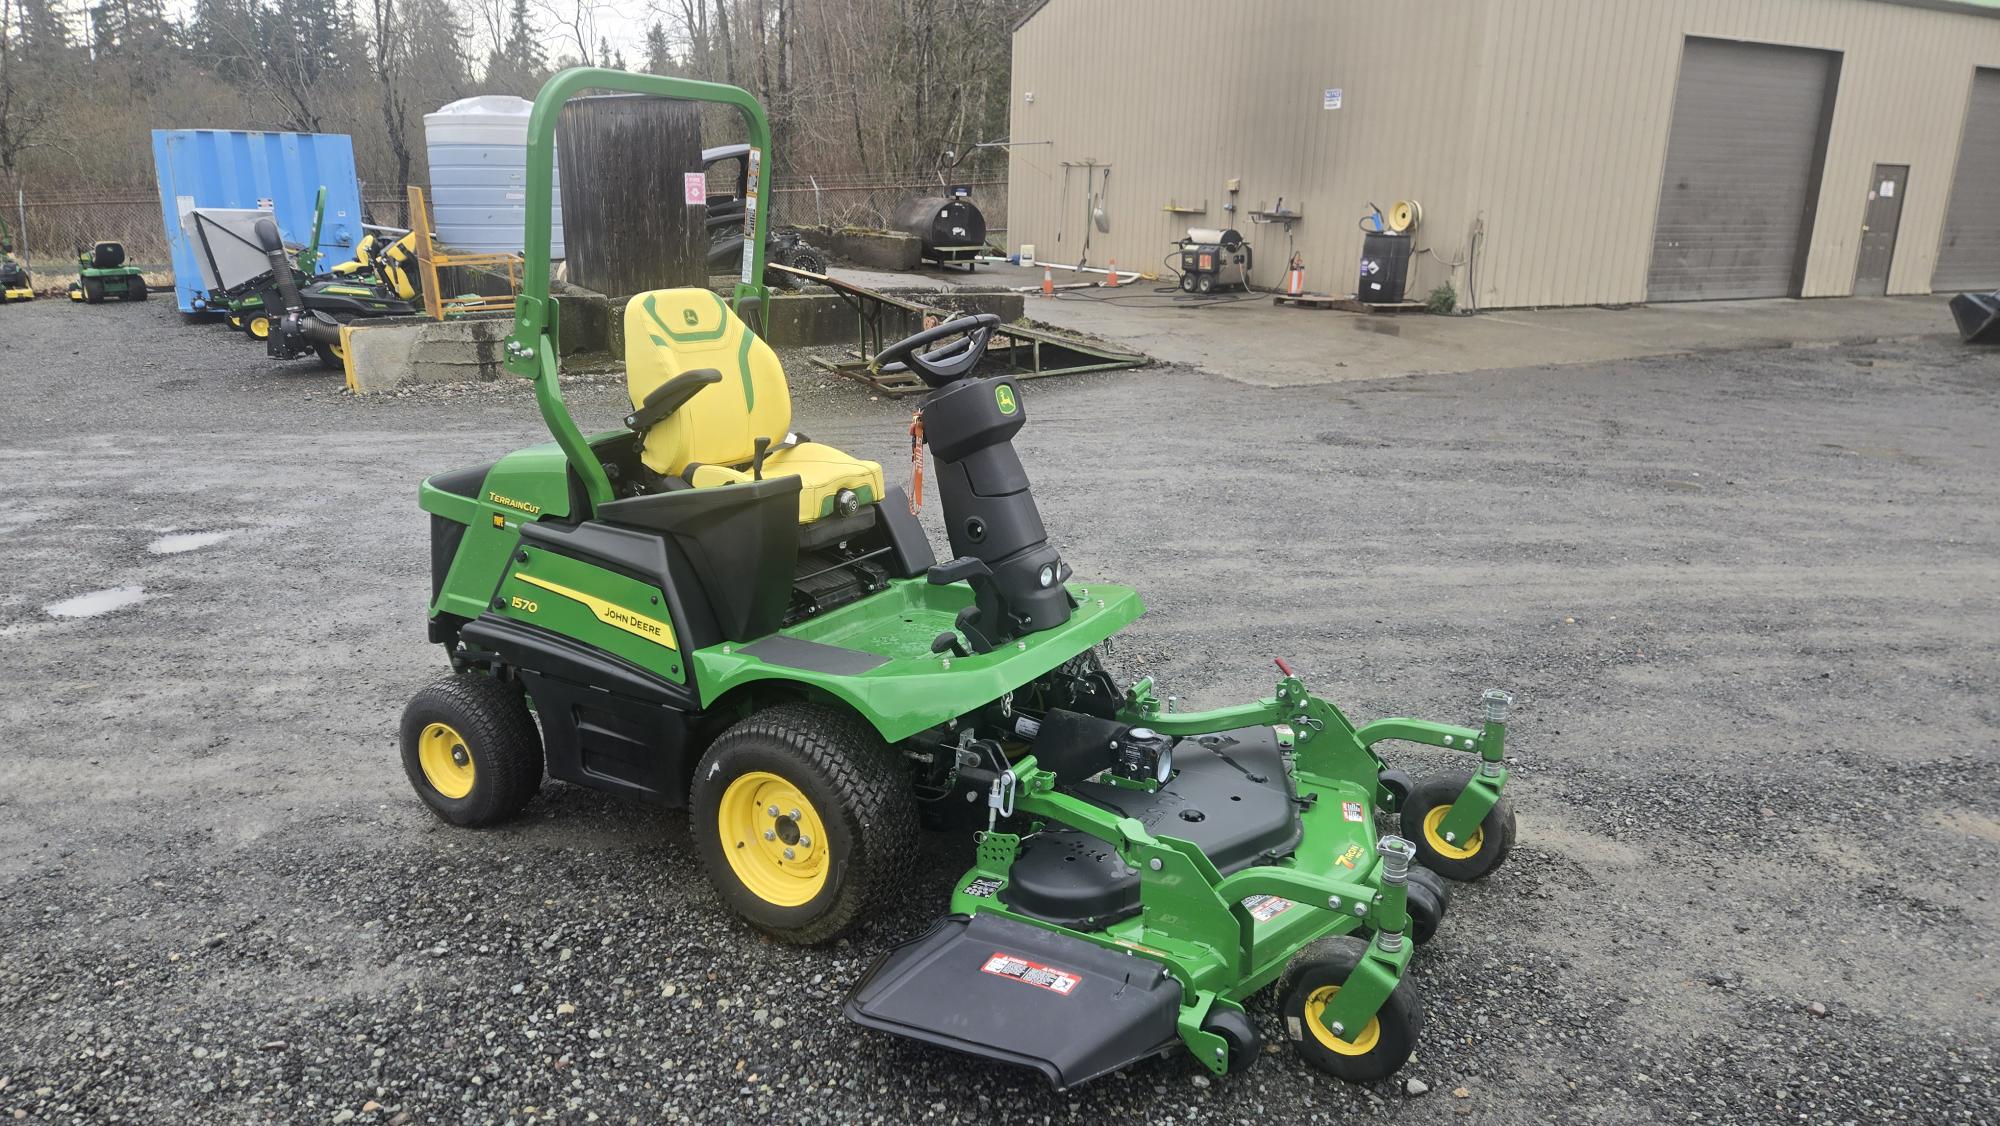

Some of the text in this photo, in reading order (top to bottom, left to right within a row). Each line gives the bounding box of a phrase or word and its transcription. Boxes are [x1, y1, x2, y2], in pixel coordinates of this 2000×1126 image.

[915, 436, 923, 471] STIHL
[511, 596, 538, 613] 1570
[604, 607, 661, 636] JOHN DEERE
